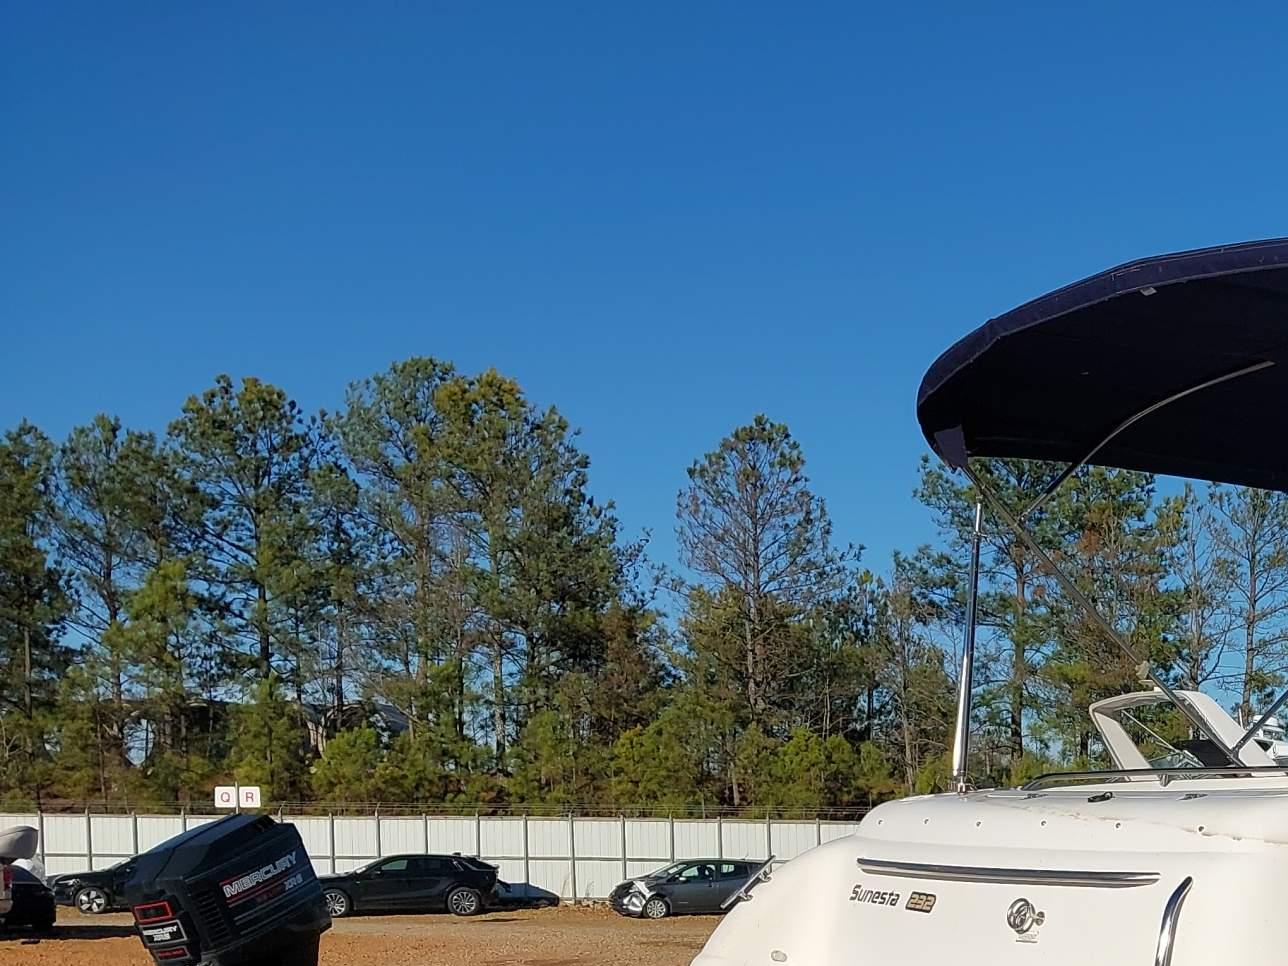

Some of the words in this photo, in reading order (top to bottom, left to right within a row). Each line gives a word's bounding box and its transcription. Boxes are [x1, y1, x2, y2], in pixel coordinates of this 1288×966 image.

[220, 791, 231, 804] Q
[245, 791, 254, 803] R
[223, 851, 297, 898] MERCURY
[849, 884, 901, 907] Sunesta
[907, 892, 936, 912] 232
